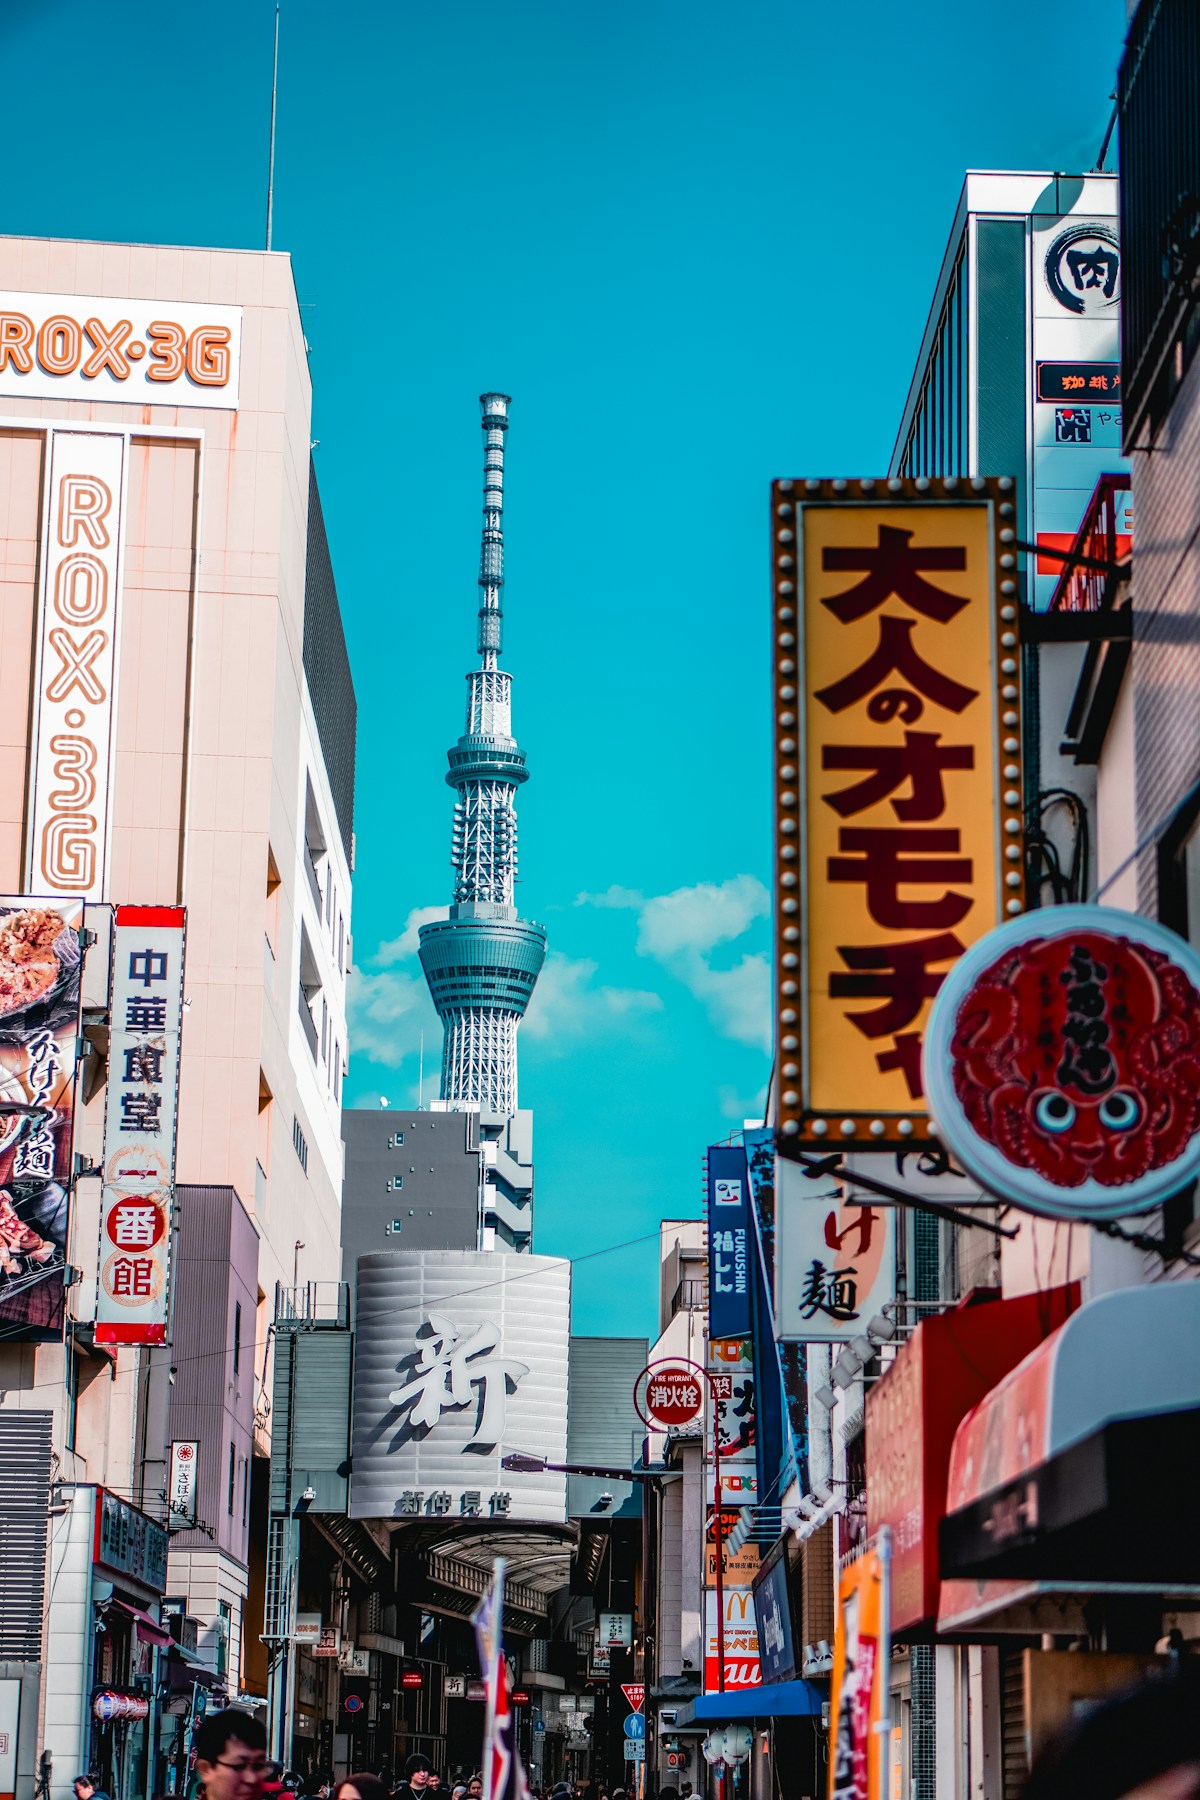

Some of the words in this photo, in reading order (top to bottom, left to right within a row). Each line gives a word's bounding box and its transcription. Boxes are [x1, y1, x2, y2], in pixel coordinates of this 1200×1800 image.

[1067, 245, 1119, 299] 肉
[119, 948, 169, 1132] 中華食堂
[112, 1169, 158, 1296] 一番館
[713, 1230, 735, 1293] 福しん
[734, 1228, 746, 1294] FUKUSHIN
[388, 1313, 530, 1444] 新
[650, 1384, 698, 1408] 消火栓
[401, 1490, 513, 1514] 新仲見世
[718, 1664, 762, 1683] au
